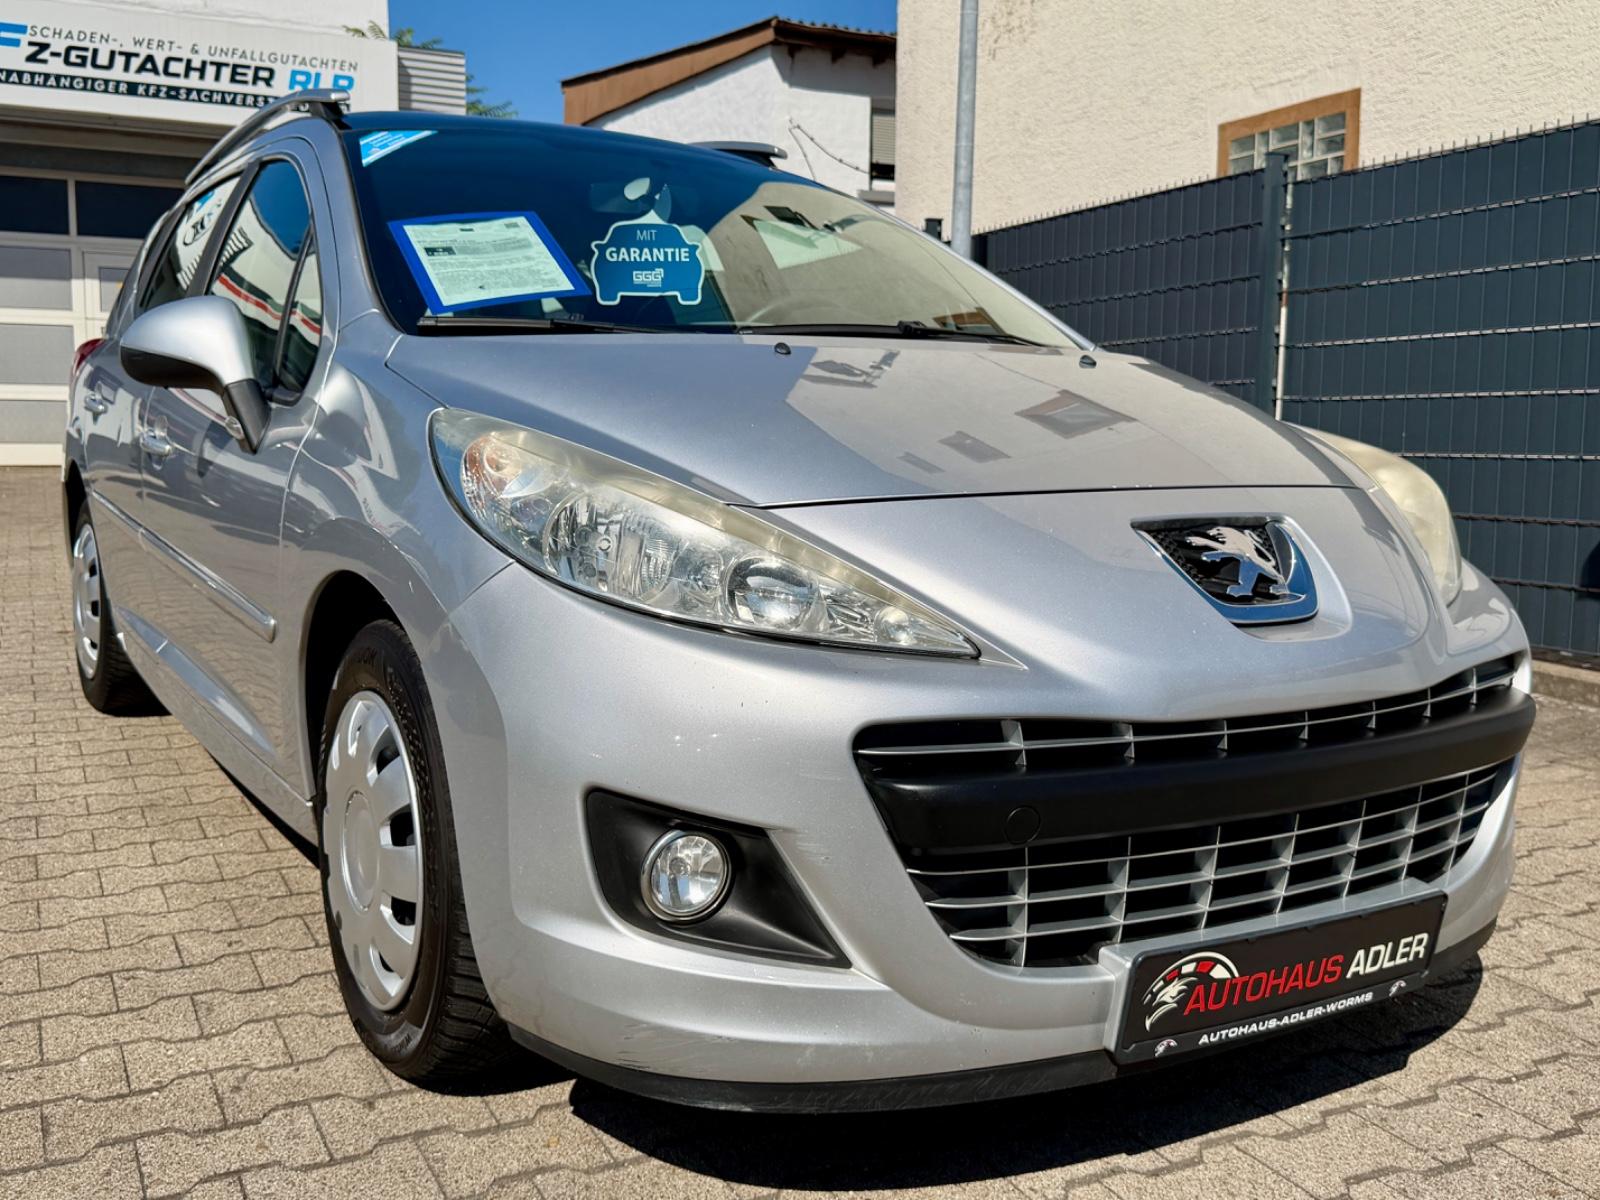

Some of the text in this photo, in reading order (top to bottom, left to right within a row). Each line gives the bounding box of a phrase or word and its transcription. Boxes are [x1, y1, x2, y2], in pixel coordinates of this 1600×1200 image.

[132, 36, 183, 51] WERT-
[190, 43, 200, 55] &
[208, 45, 358, 71] UNFALLGUTACHTEN
[636, 230, 657, 241] MIT
[605, 247, 690, 262] GARANTIE
[1184, 932, 1429, 1016] AUTOHAUS ADLER
[1199, 991, 1374, 1045] AUTOHAUS-ADLER-WORMS
